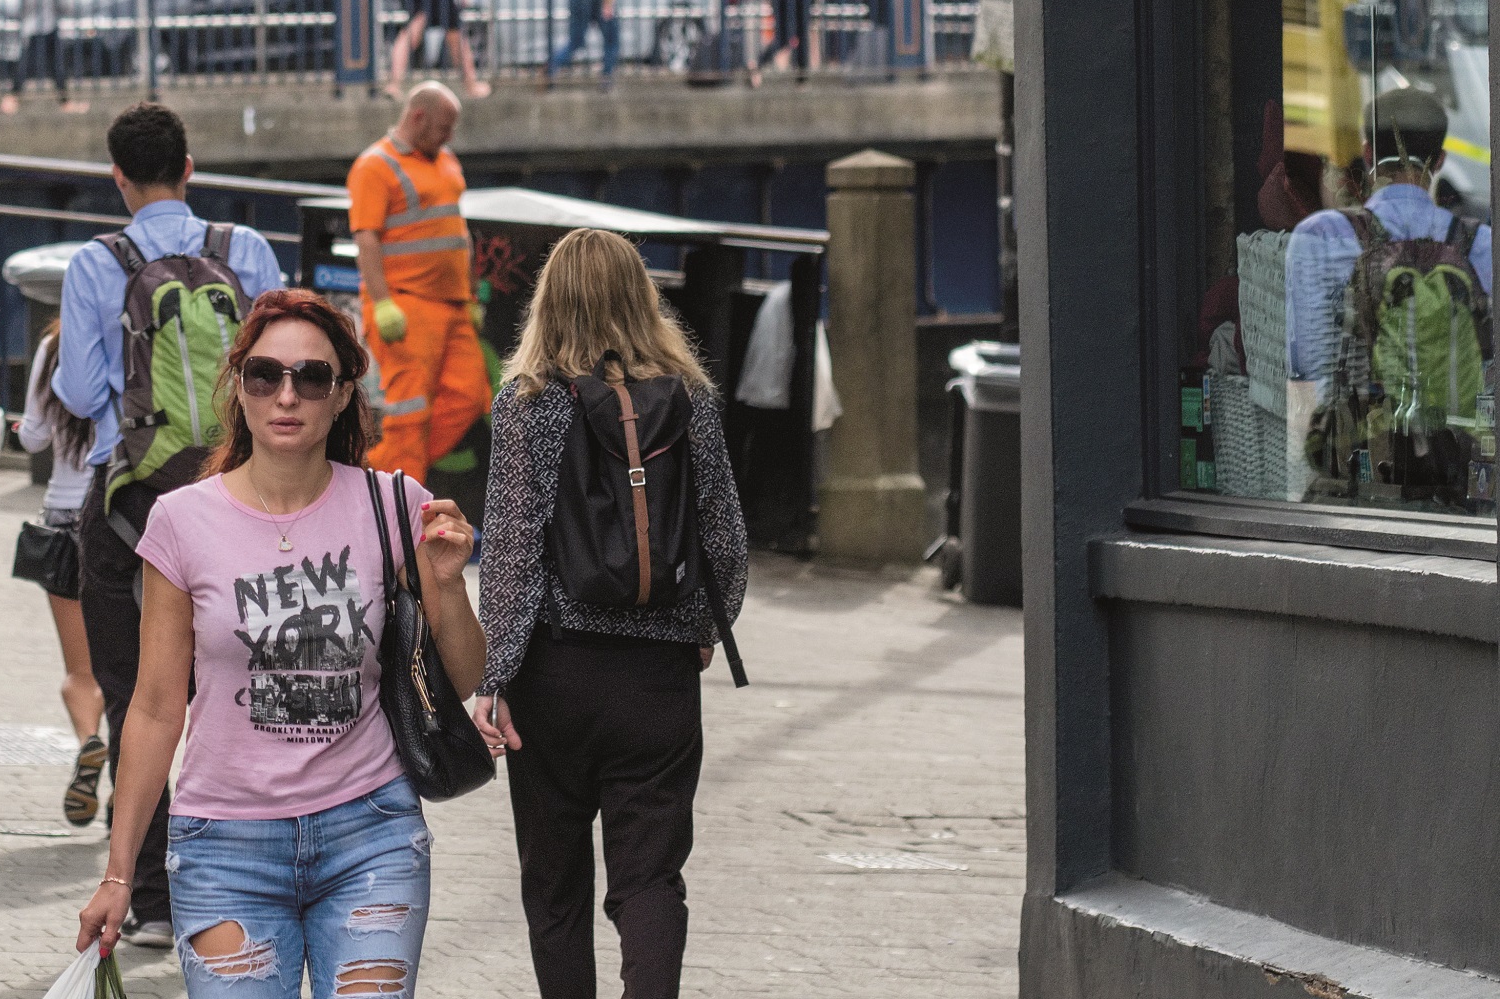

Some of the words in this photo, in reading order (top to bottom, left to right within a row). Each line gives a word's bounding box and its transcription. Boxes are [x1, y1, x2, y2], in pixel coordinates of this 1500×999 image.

[234, 545, 350, 624] NEW
[234, 598, 376, 671] YORK
[253, 723, 302, 734] BROOKLYN
[286, 736, 332, 744] MIDTOWN
